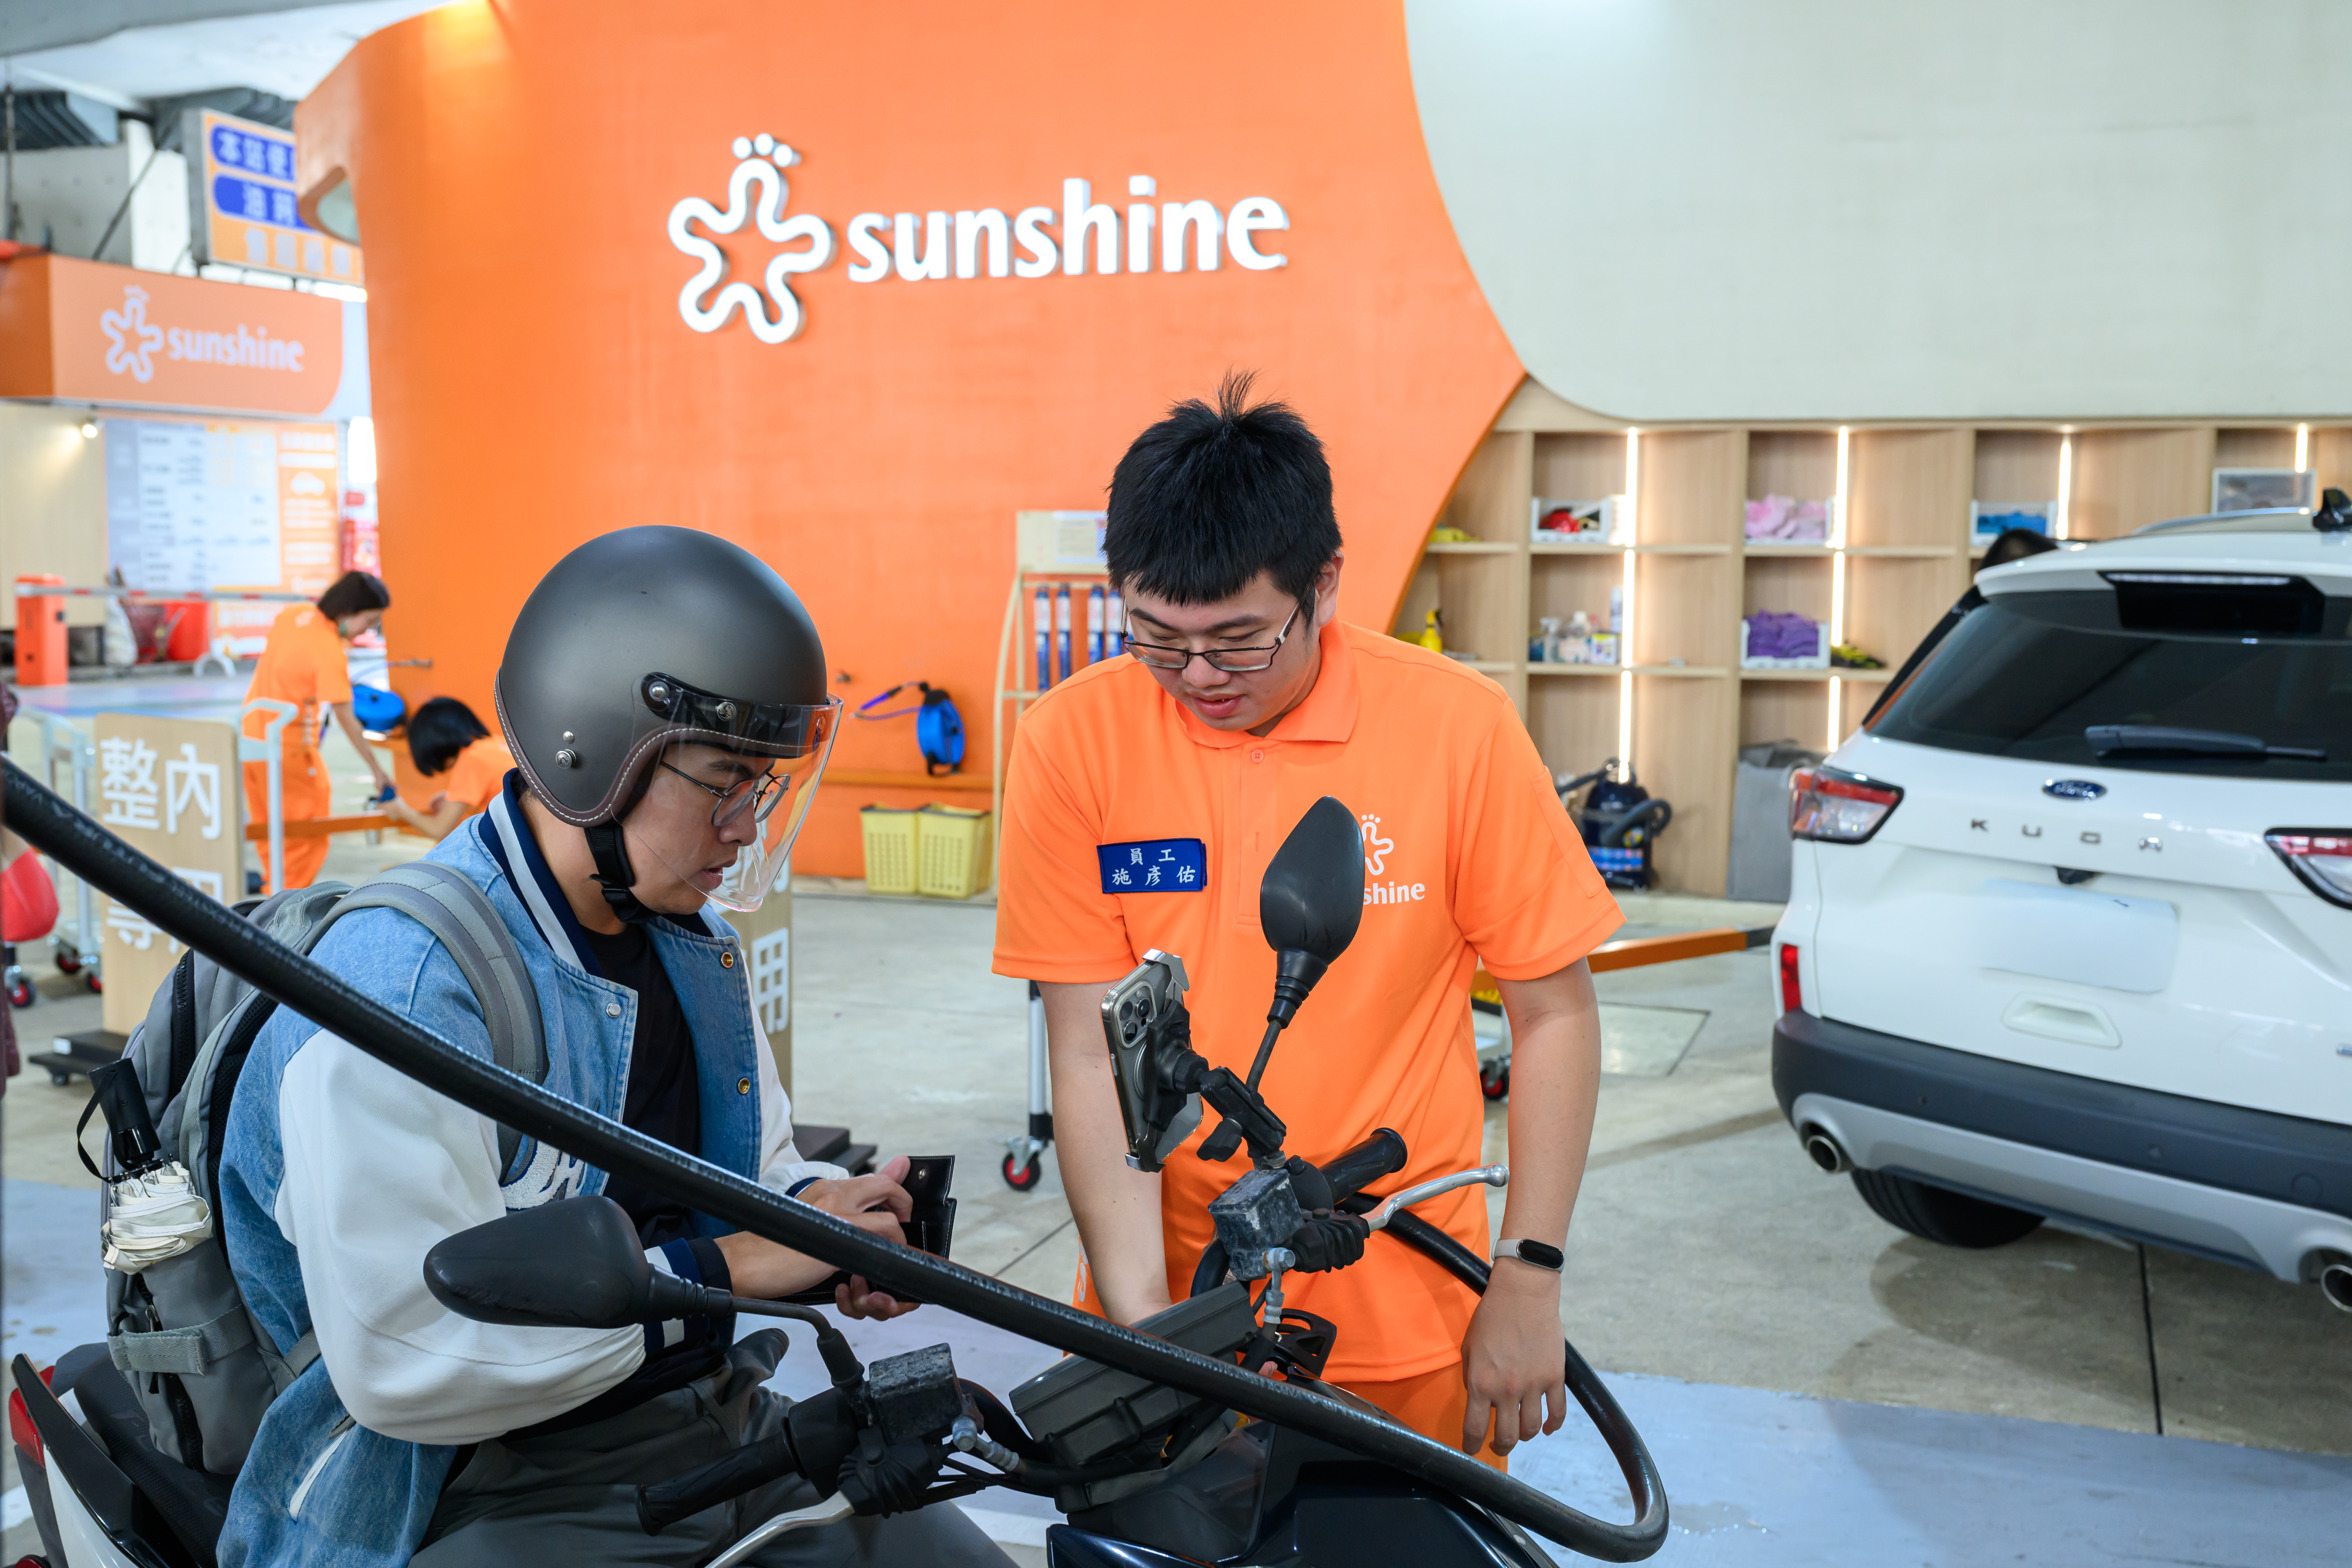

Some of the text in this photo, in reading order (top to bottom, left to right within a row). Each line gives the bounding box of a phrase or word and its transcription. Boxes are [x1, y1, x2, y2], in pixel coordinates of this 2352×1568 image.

[847, 176, 1289, 283] sunshine
[167, 324, 305, 372] sunshine
[1129, 848, 1176, 866] 員工
[1363, 882, 1425, 905] shine
